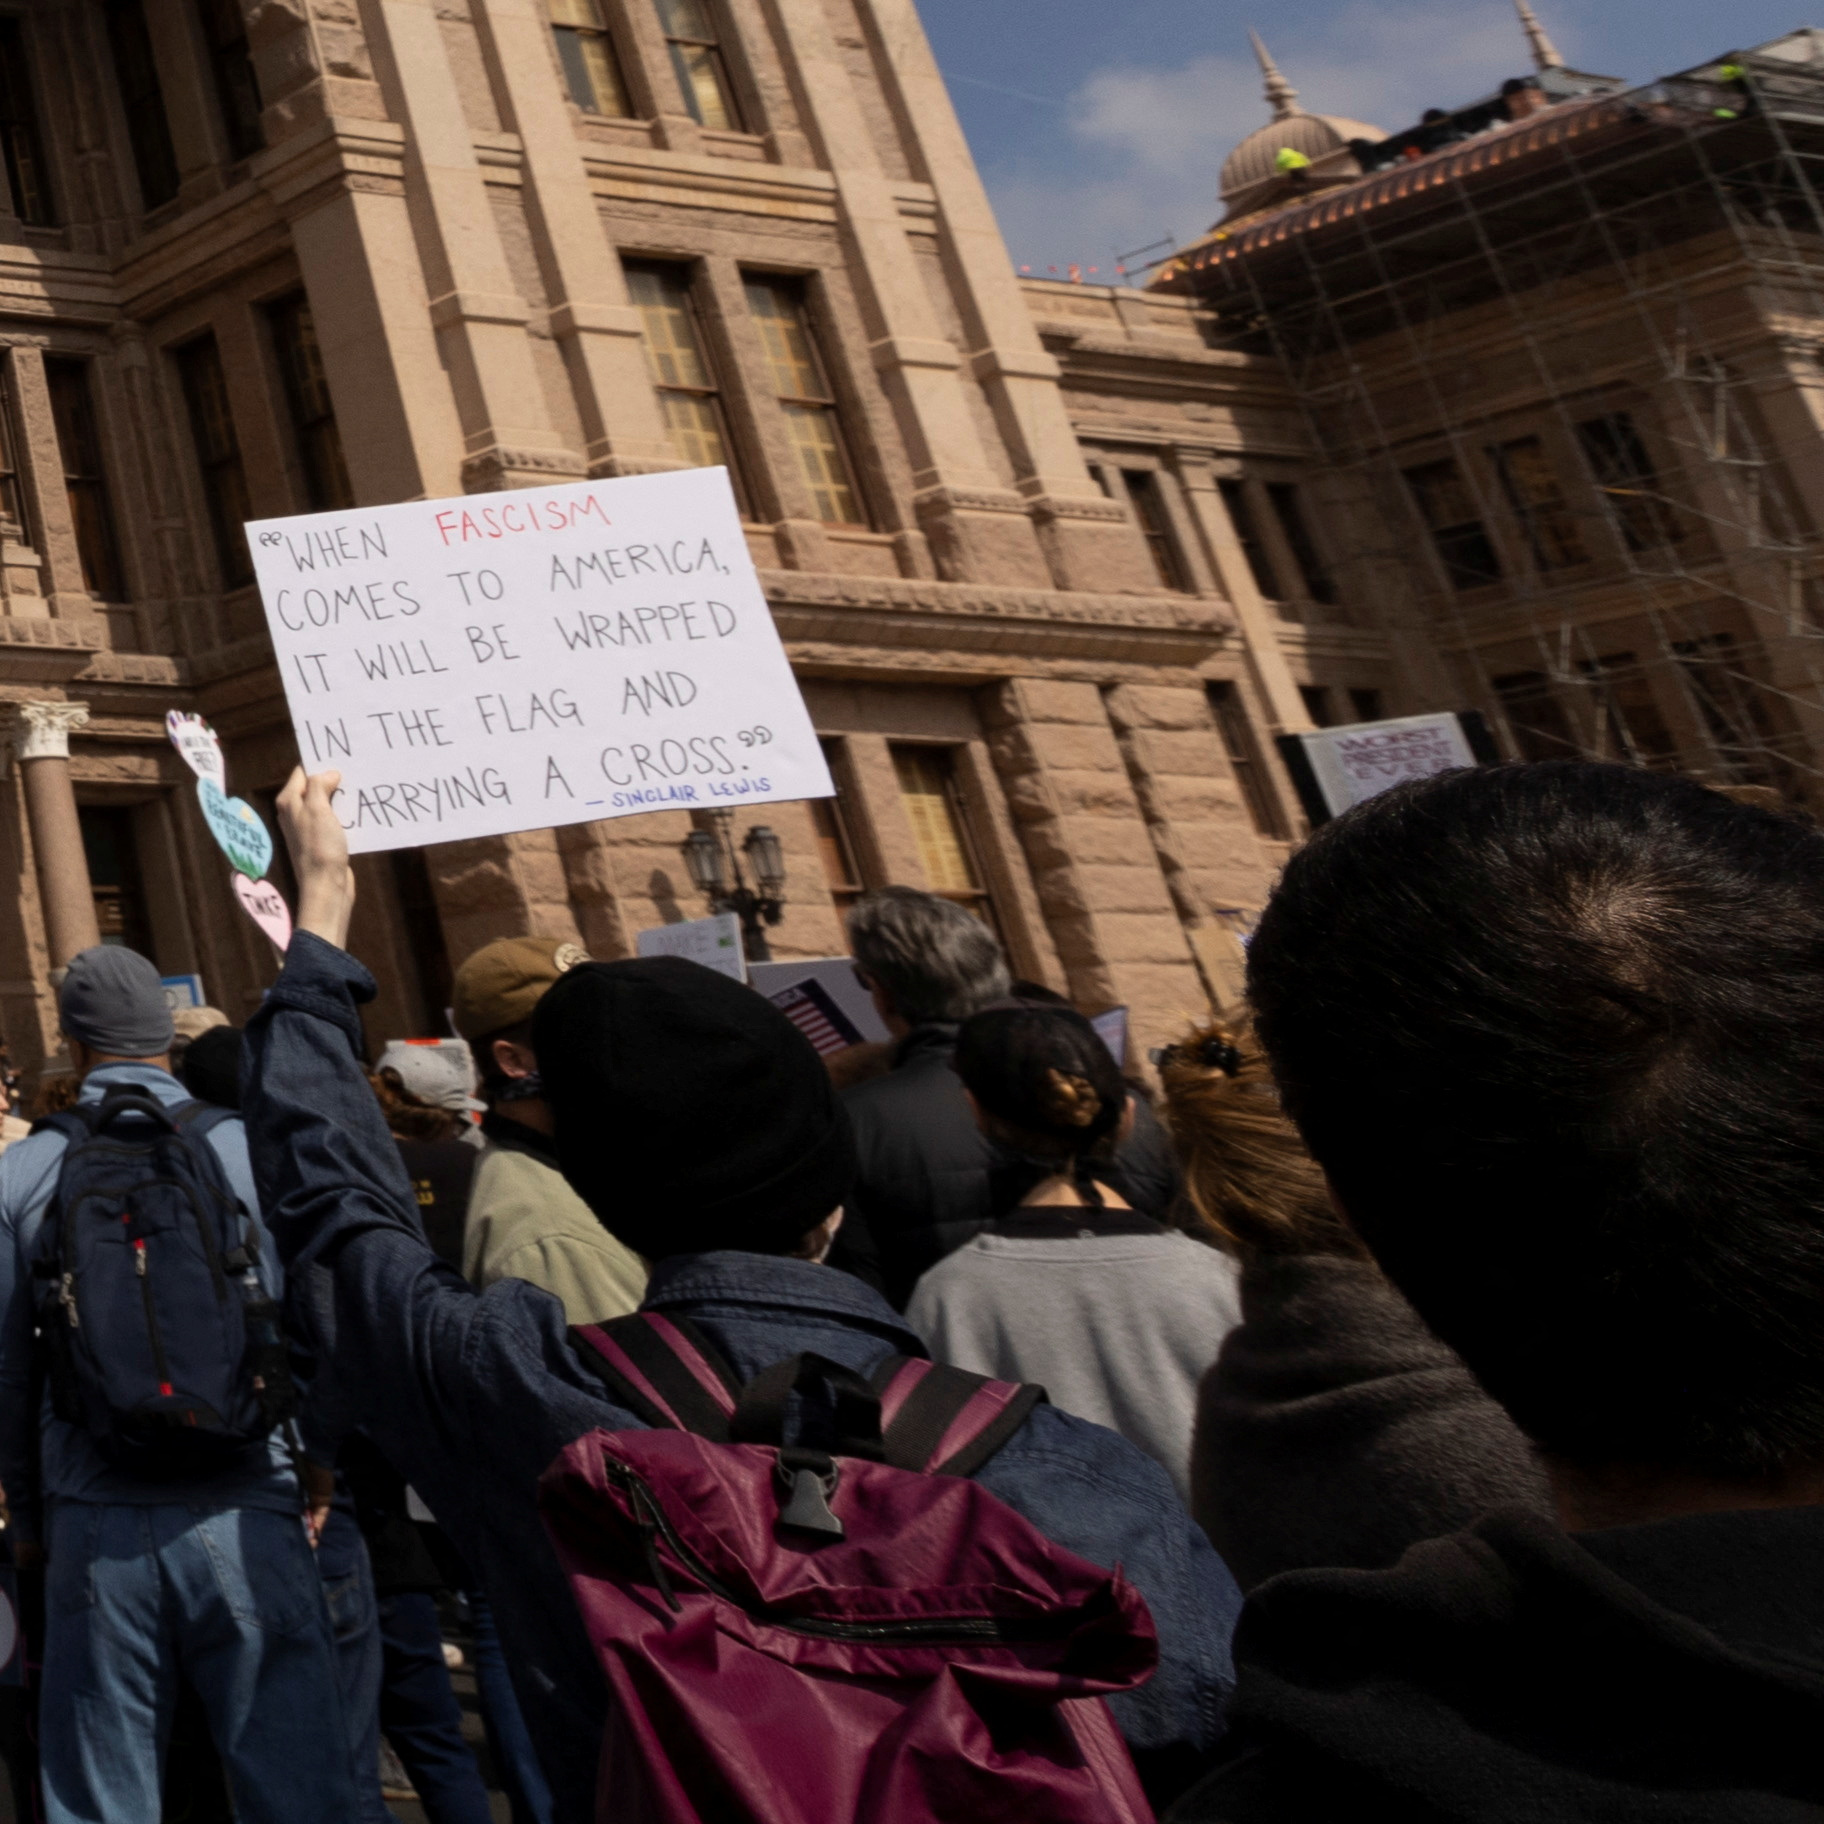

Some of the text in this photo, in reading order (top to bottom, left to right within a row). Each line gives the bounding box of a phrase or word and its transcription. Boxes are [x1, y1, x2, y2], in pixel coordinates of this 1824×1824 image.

[435, 494, 611, 547] FASCISM
[276, 537, 731, 631] COMES TO AMERICA,
[293, 600, 737, 694] IT WILL BE WRAPPED
[303, 670, 698, 763] IN THE FLAG AND
[1334, 727, 1441, 751] WORST
[330, 766, 510, 832] CARRYING
[544, 755, 575, 799] A
[612, 783, 700, 810] SINCLAIR
[712, 776, 771, 798] LEWIS
